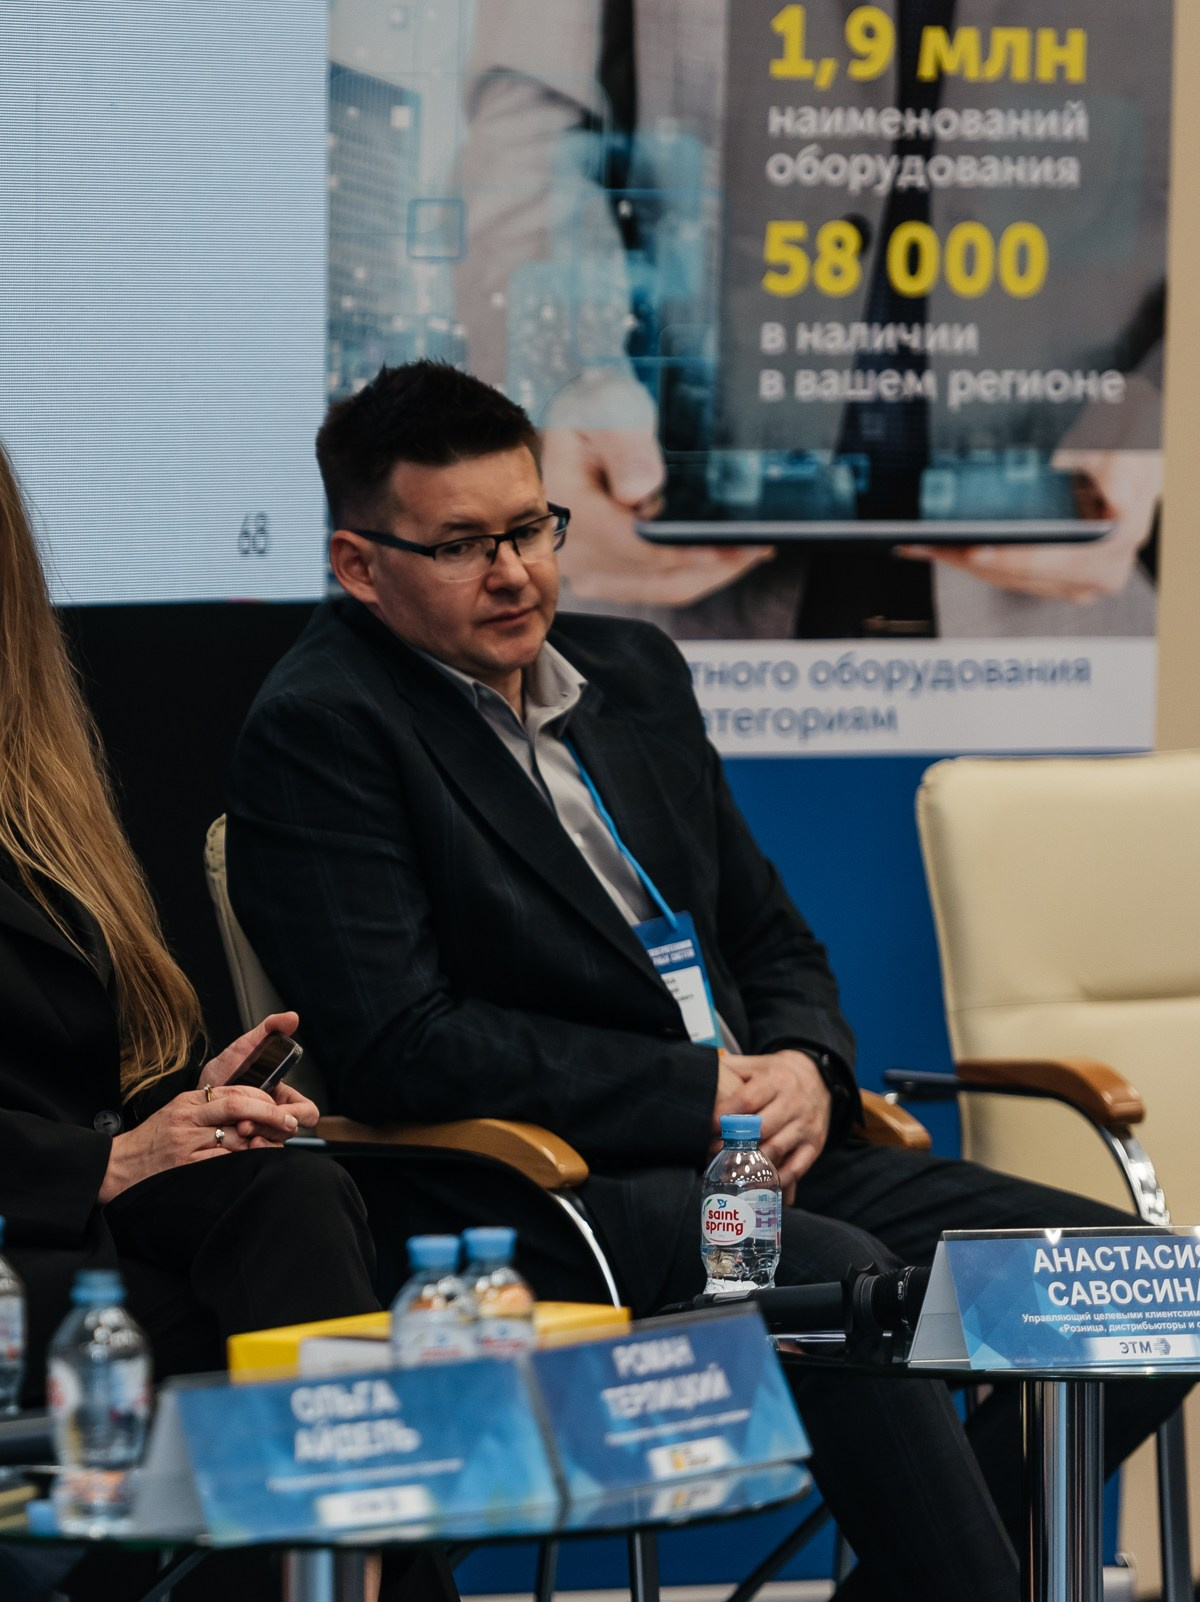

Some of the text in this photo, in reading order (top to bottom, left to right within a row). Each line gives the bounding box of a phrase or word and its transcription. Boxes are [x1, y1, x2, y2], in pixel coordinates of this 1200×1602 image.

[768, 3, 896, 91] 1,9
[767, 99, 1090, 142] наименований
[765, 143, 1081, 196] оборудования
[761, 219, 1049, 299] 58 000
[760, 322, 980, 355] в наличии
[758, 369, 1126, 411] в вашем регионе
[238, 511, 269, 558] 68
[808, 651, 1093, 693] оборудования
[705, 1220, 744, 1236] spring
[708, 1209, 740, 1221] saint
[1033, 1245, 1200, 1273] АНАСТАСИ
[1048, 1278, 1200, 1306] САВОСИН
[1022, 1312, 1091, 1324] Управляющий
[1093, 1312, 1143, 1321] целевыми
[1109, 1321, 1186, 1333] дистрибьюторы
[1119, 1341, 1153, 1355] ЭТМ
